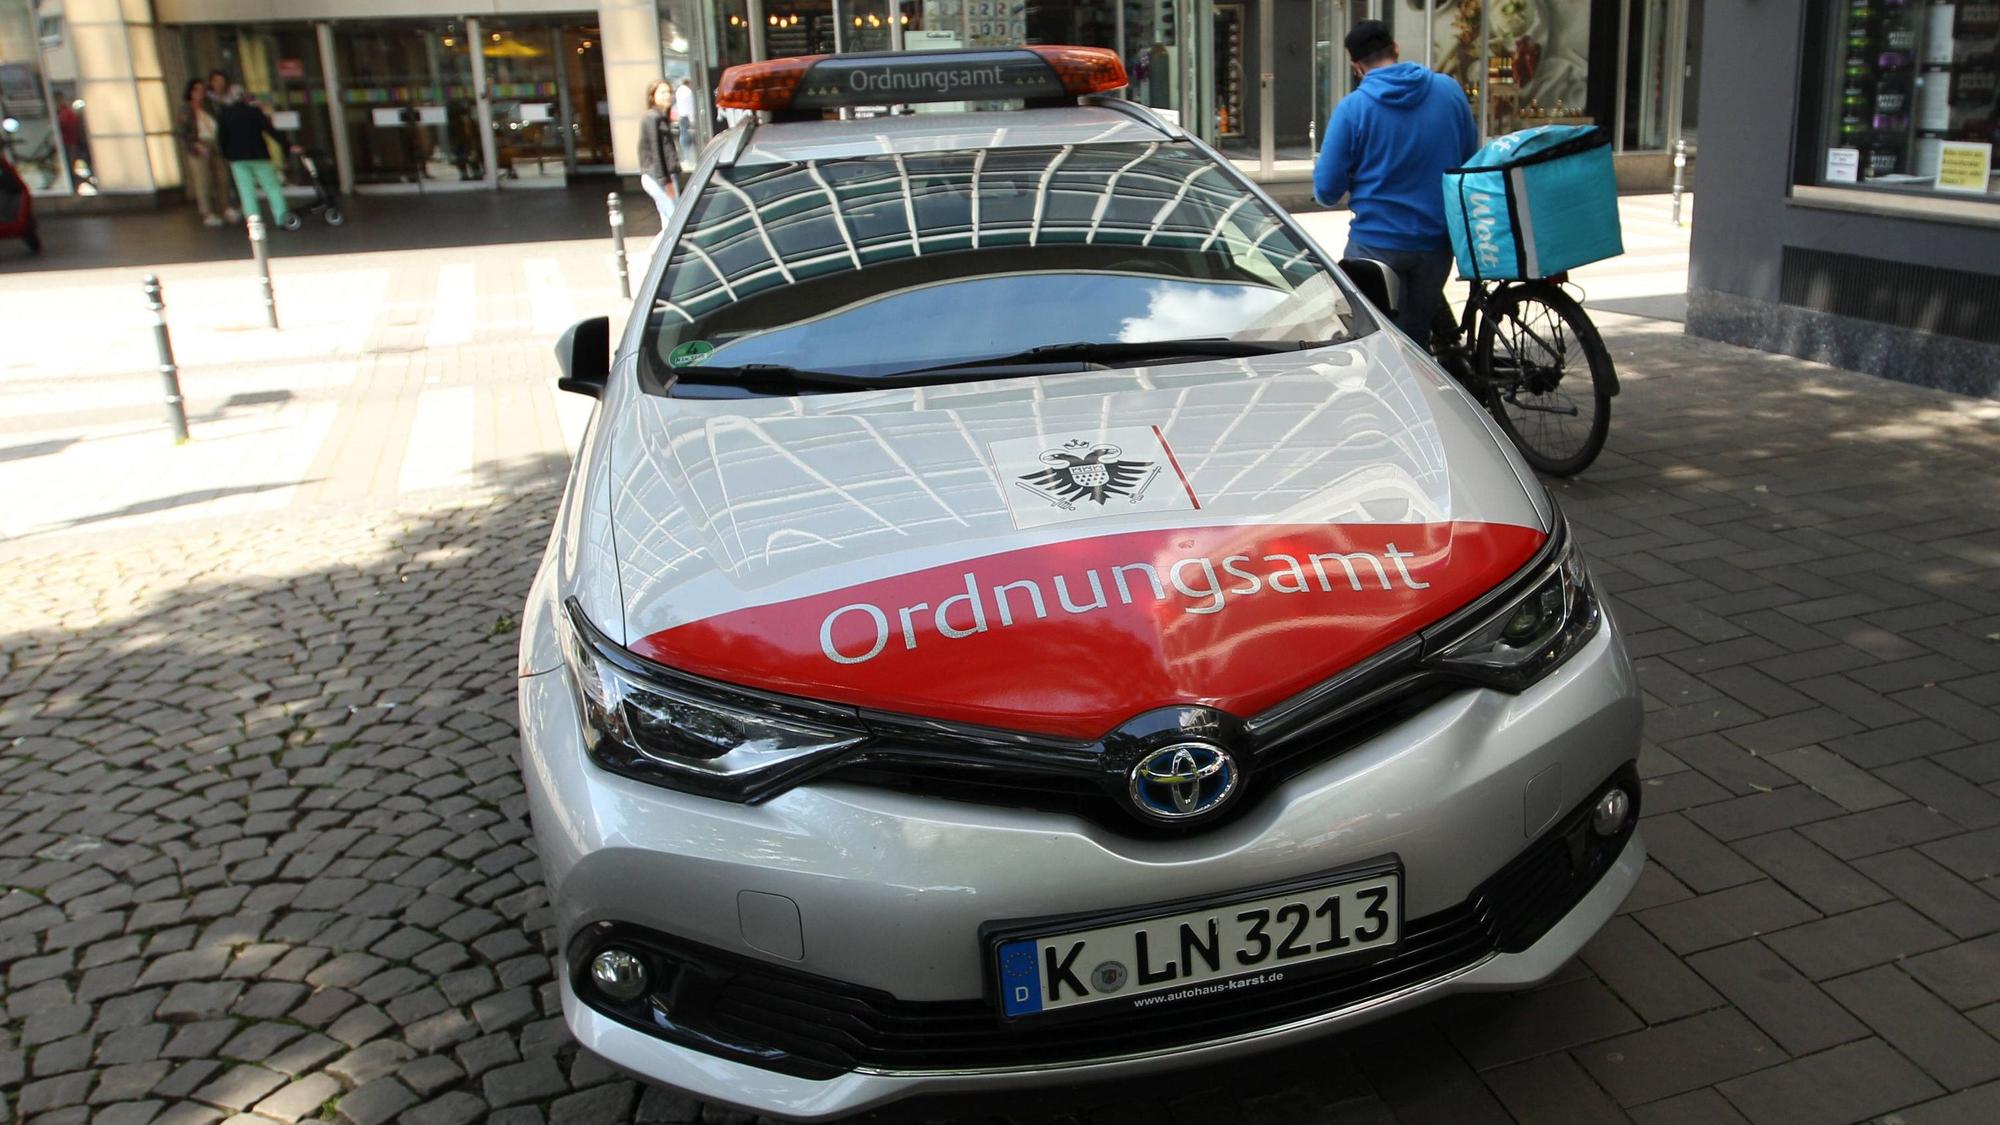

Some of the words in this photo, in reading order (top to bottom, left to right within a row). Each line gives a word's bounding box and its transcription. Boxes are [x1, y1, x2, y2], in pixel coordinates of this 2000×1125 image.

[850, 65, 1005, 92] Ordnungsamt
[1469, 192, 1499, 268] Wolt
[819, 543, 1430, 665] Ordnungsamt
[1044, 940, 1090, 1001] K
[1135, 917, 1220, 986] LN
[1235, 886, 1389, 966] 3213
[1015, 986, 1029, 1002] D
[1133, 972, 1284, 1008] www.autohaus-karst.de
